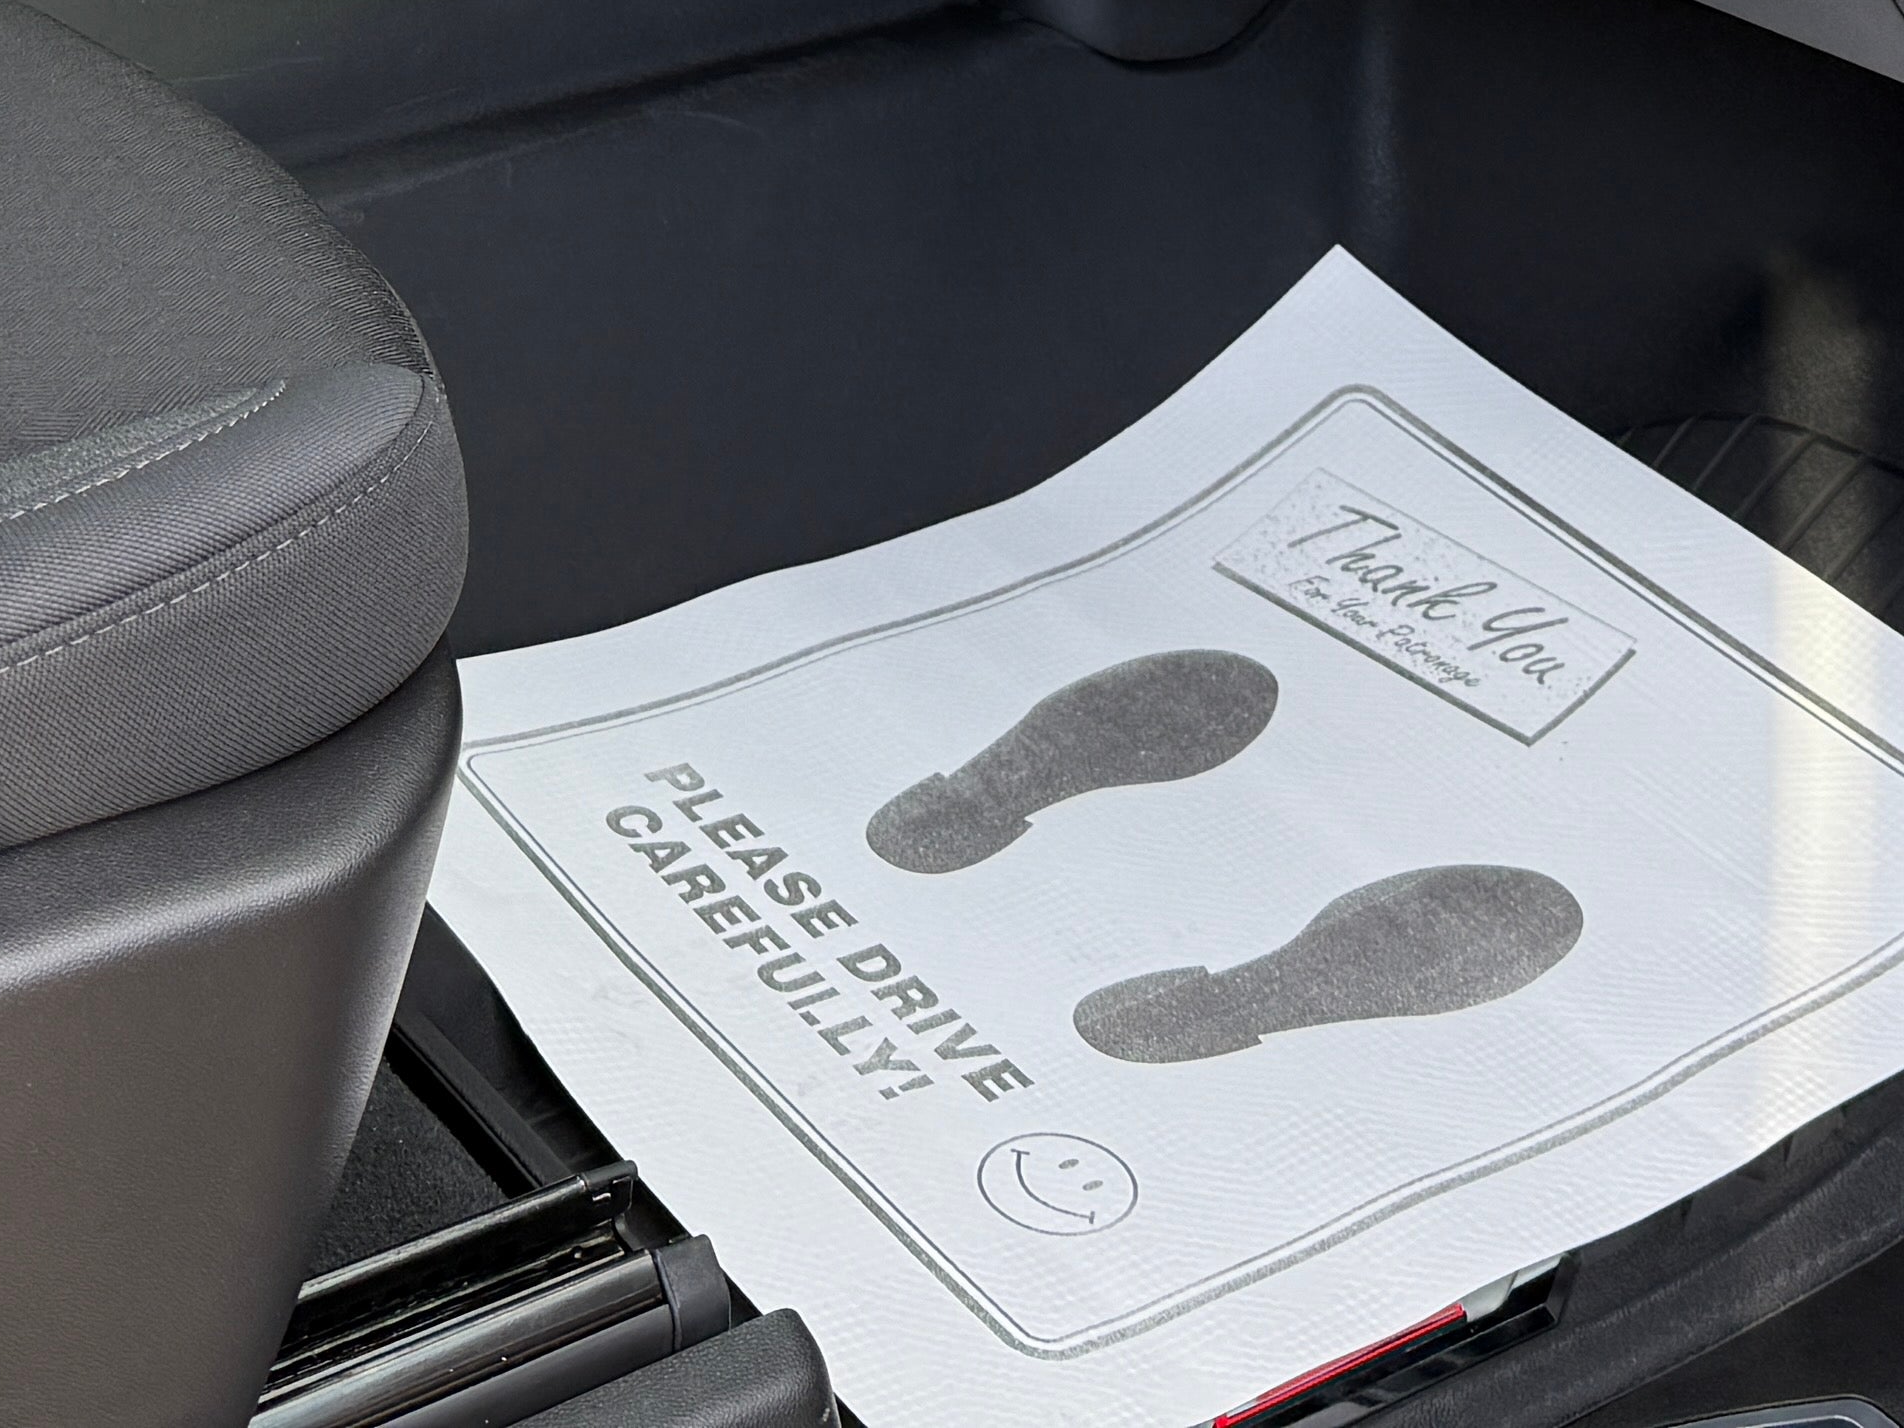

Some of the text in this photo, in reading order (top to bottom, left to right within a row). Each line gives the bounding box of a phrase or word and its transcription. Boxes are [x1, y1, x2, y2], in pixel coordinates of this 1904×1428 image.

[1287, 504, 1571, 685] Thank You
[1289, 575, 1483, 689] For Your Patronage
[605, 804, 935, 1101] CAREFULLY!
[643, 762, 1036, 1103] PLEASE DRIVE
